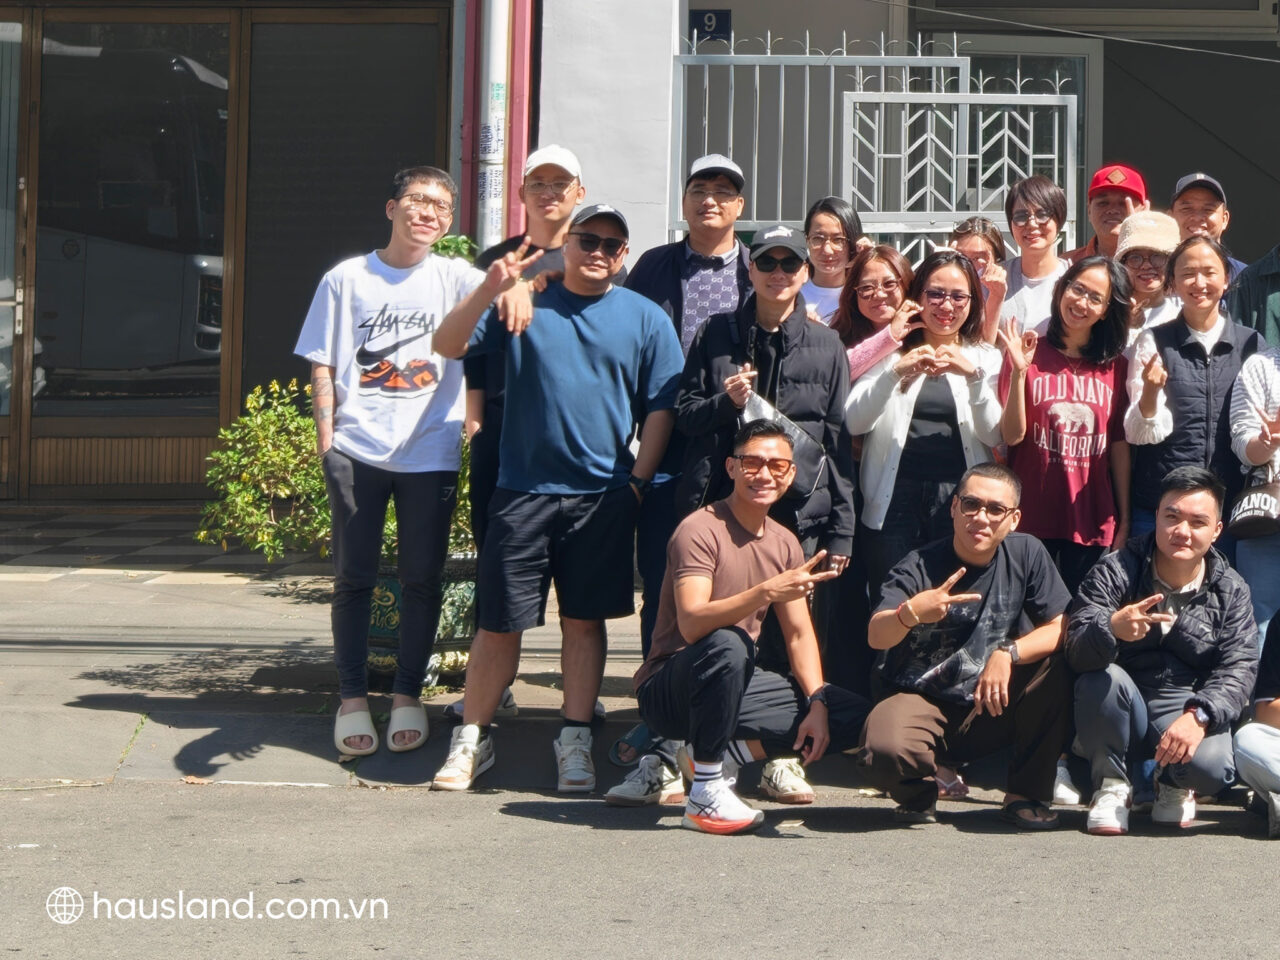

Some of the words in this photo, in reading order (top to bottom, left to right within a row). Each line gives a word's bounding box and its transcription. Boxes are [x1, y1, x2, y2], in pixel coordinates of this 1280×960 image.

[704, 13, 717, 32] 9
[1033, 373, 1067, 406] OLD
[1072, 374, 1113, 417] NAVY
[1033, 421, 1107, 458] CALIFORNIA
